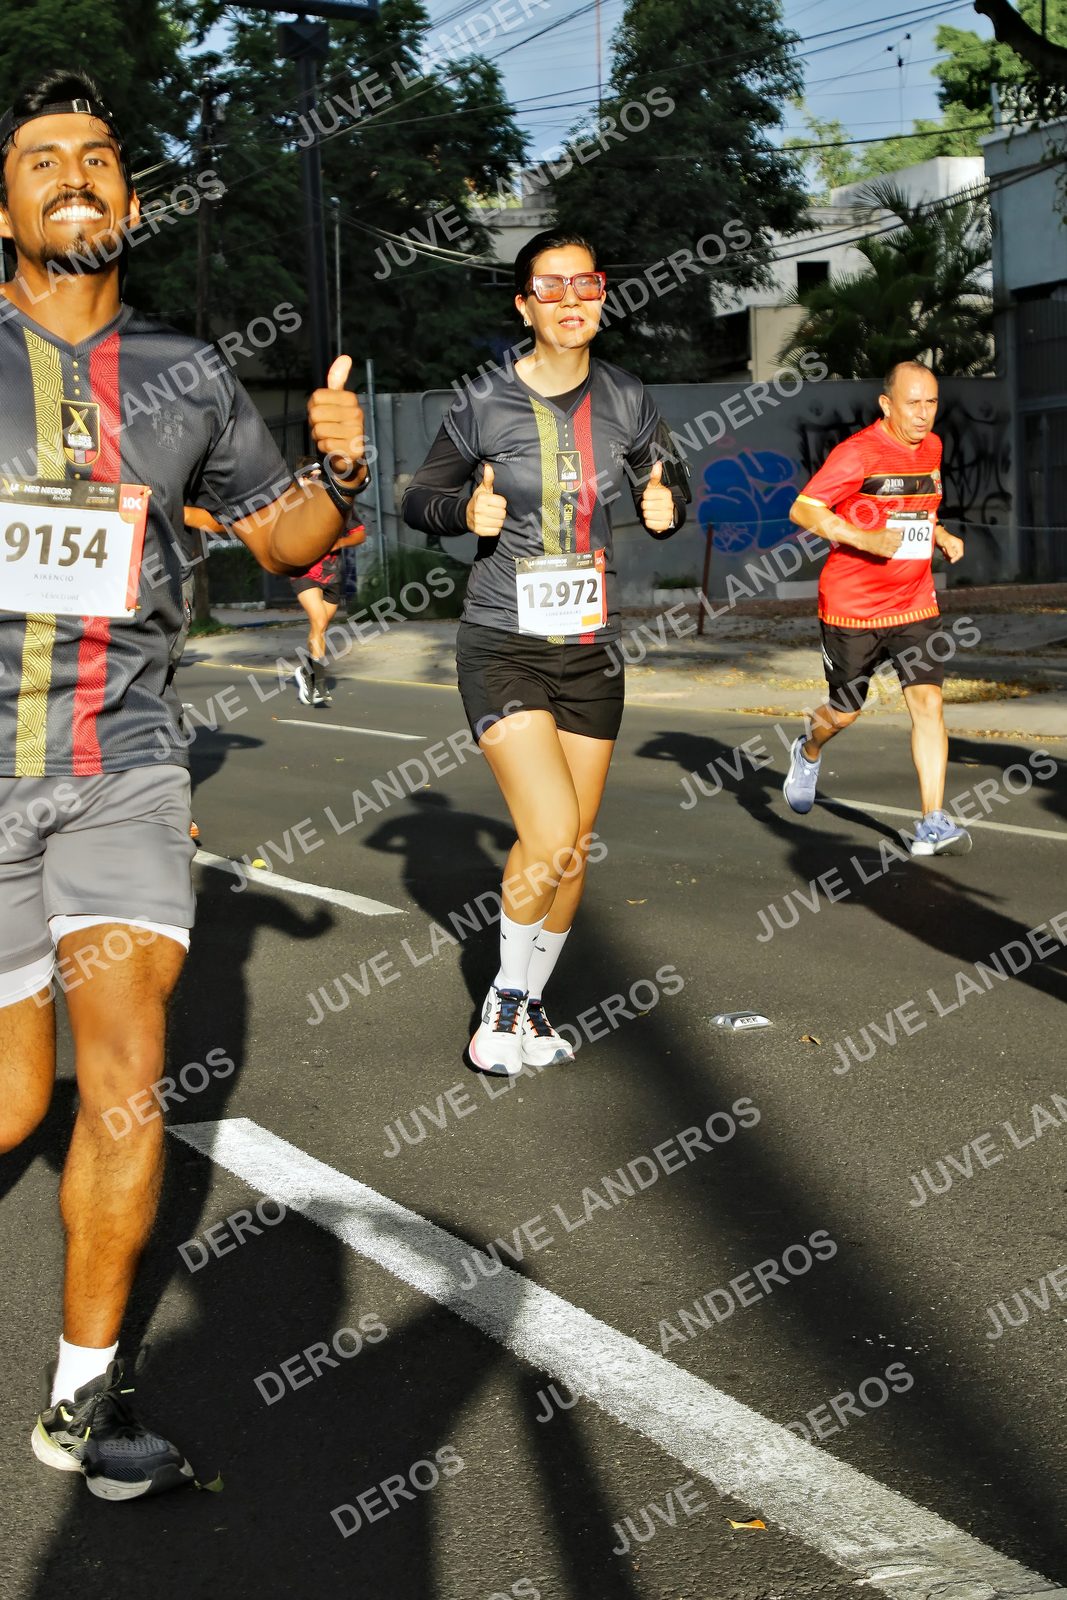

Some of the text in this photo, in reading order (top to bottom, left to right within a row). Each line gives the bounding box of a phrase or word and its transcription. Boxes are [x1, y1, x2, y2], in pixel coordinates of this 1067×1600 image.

[123, 497, 142, 510] 10K
[5, 521, 108, 569] 9154
[522, 578, 598, 609] 12972
